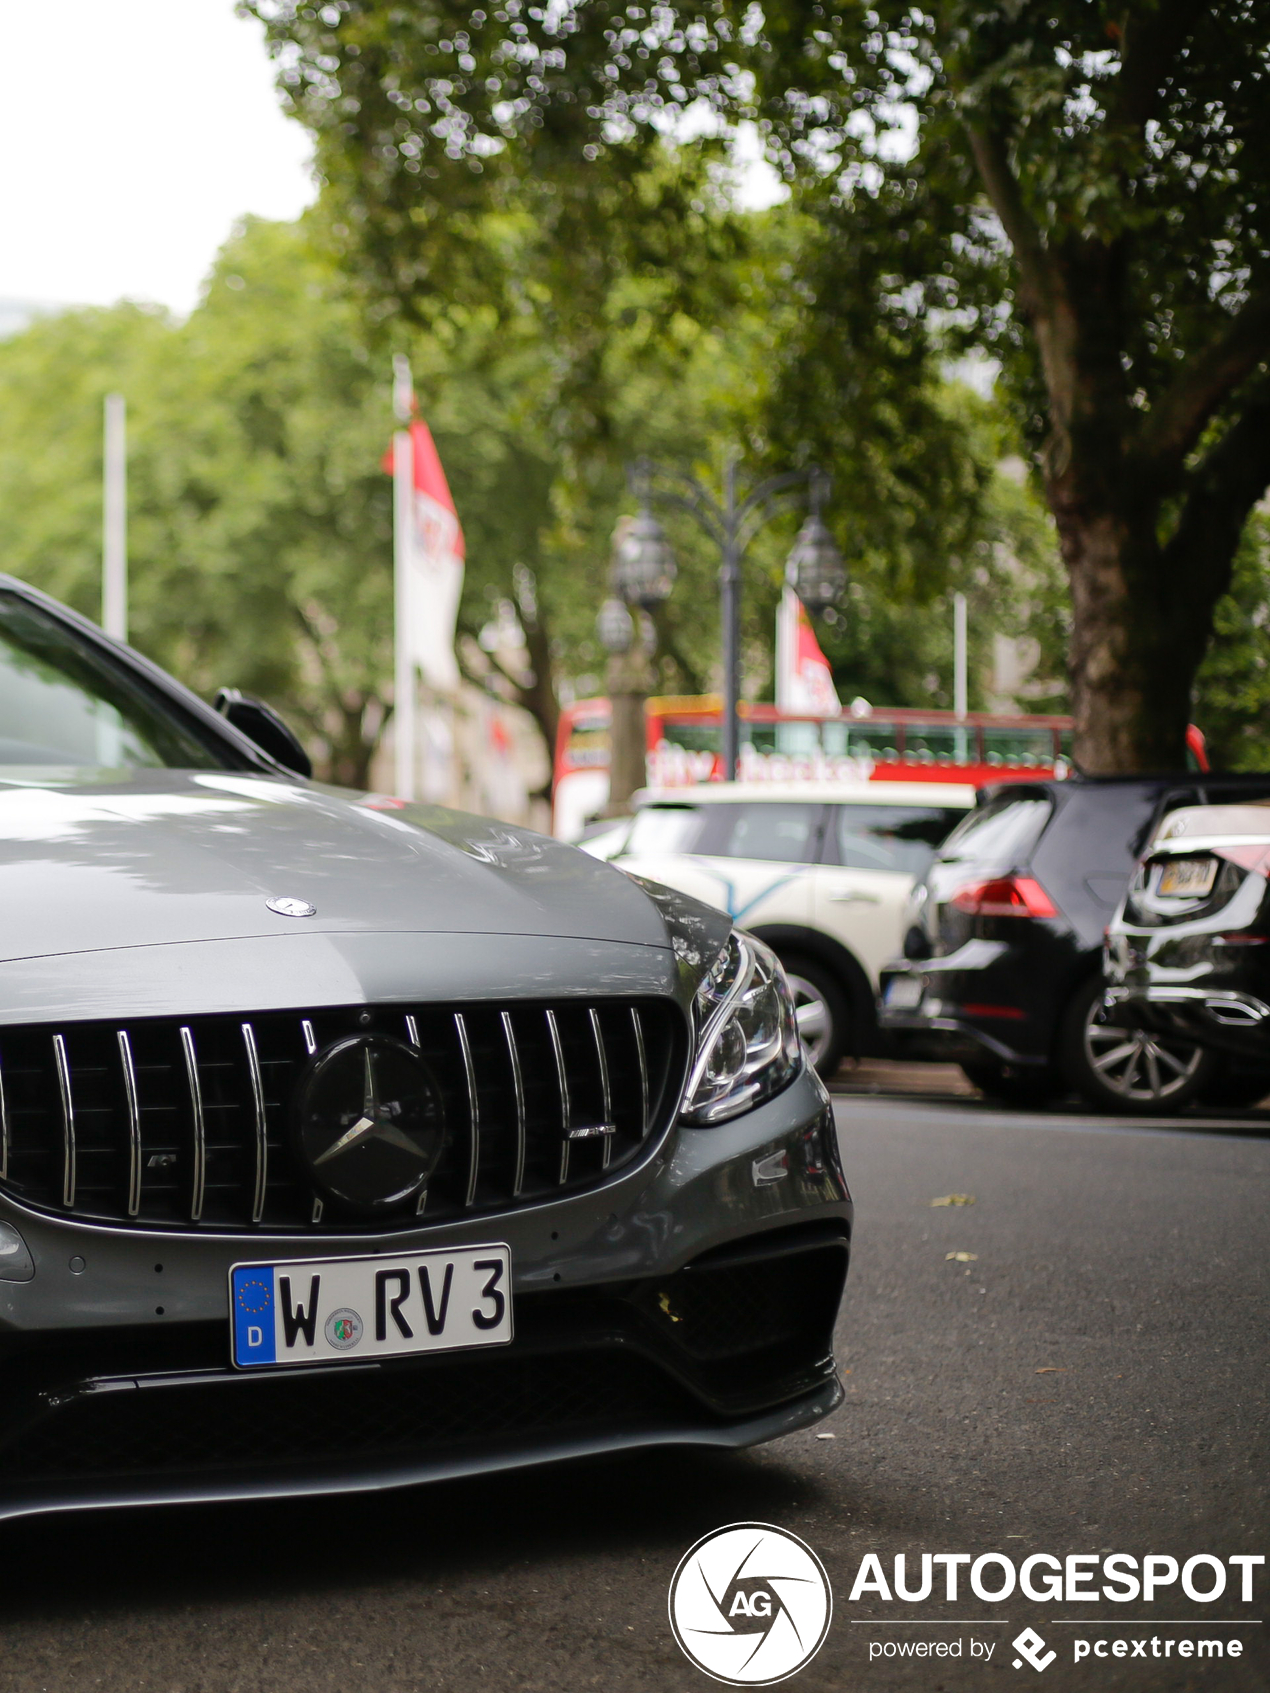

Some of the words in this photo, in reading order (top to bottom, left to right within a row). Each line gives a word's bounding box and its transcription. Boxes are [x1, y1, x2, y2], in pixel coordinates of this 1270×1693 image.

[279, 1275, 320, 1347] W
[375, 1263, 454, 1341] RV
[472, 1258, 506, 1330] 3
[248, 1326, 263, 1347] D
